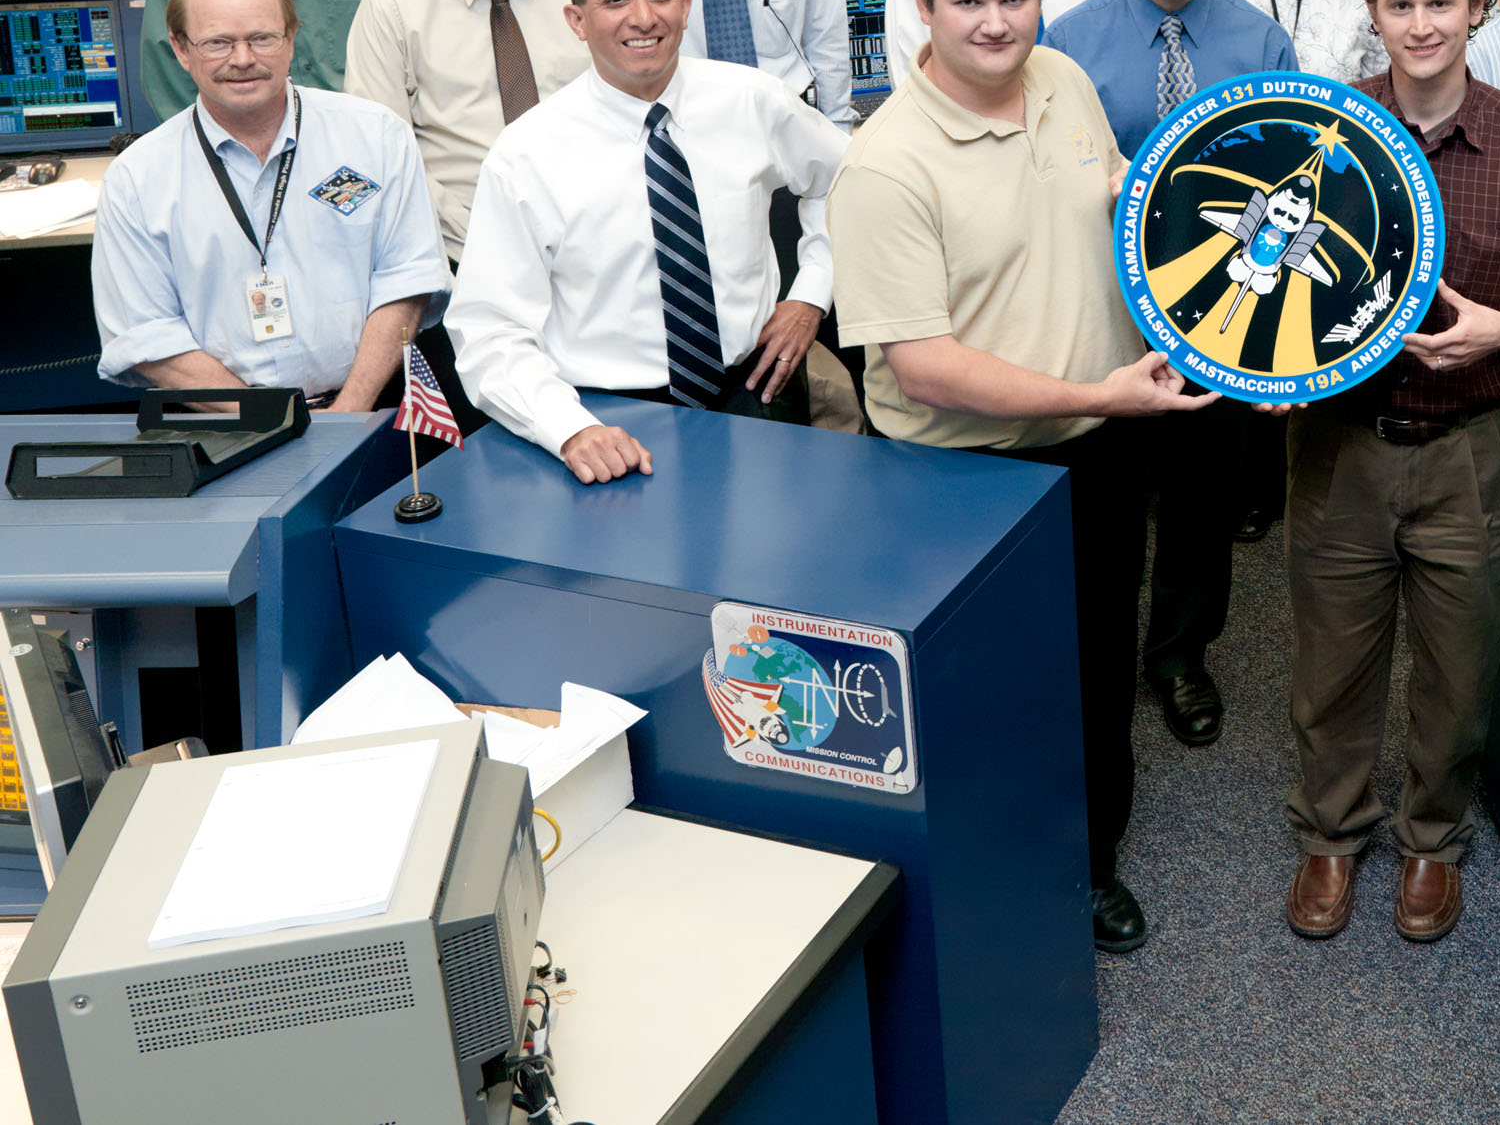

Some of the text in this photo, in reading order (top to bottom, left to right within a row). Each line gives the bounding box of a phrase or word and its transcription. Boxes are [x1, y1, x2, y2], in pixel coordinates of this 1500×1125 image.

[1222, 83, 1254, 104] 131
[1263, 82, 1332, 101] DUTTON
[1141, 98, 1218, 174] POINDEXTER
[1343, 97, 1434, 284] METCALF-LINDENBURGER
[1128, 200, 1142, 287] YAMAZAKI
[1137, 294, 1180, 350] WILSON
[1351, 296, 1420, 372] ANDERSON
[1185, 353, 1296, 393] MASTRACCHIO
[1305, 370, 1344, 392] 19A
[752, 613, 892, 647] INSTRUMENTATION
[745, 751, 885, 787] COMMUNICATIONS
[806, 746, 877, 765] MISSION CONTROL
